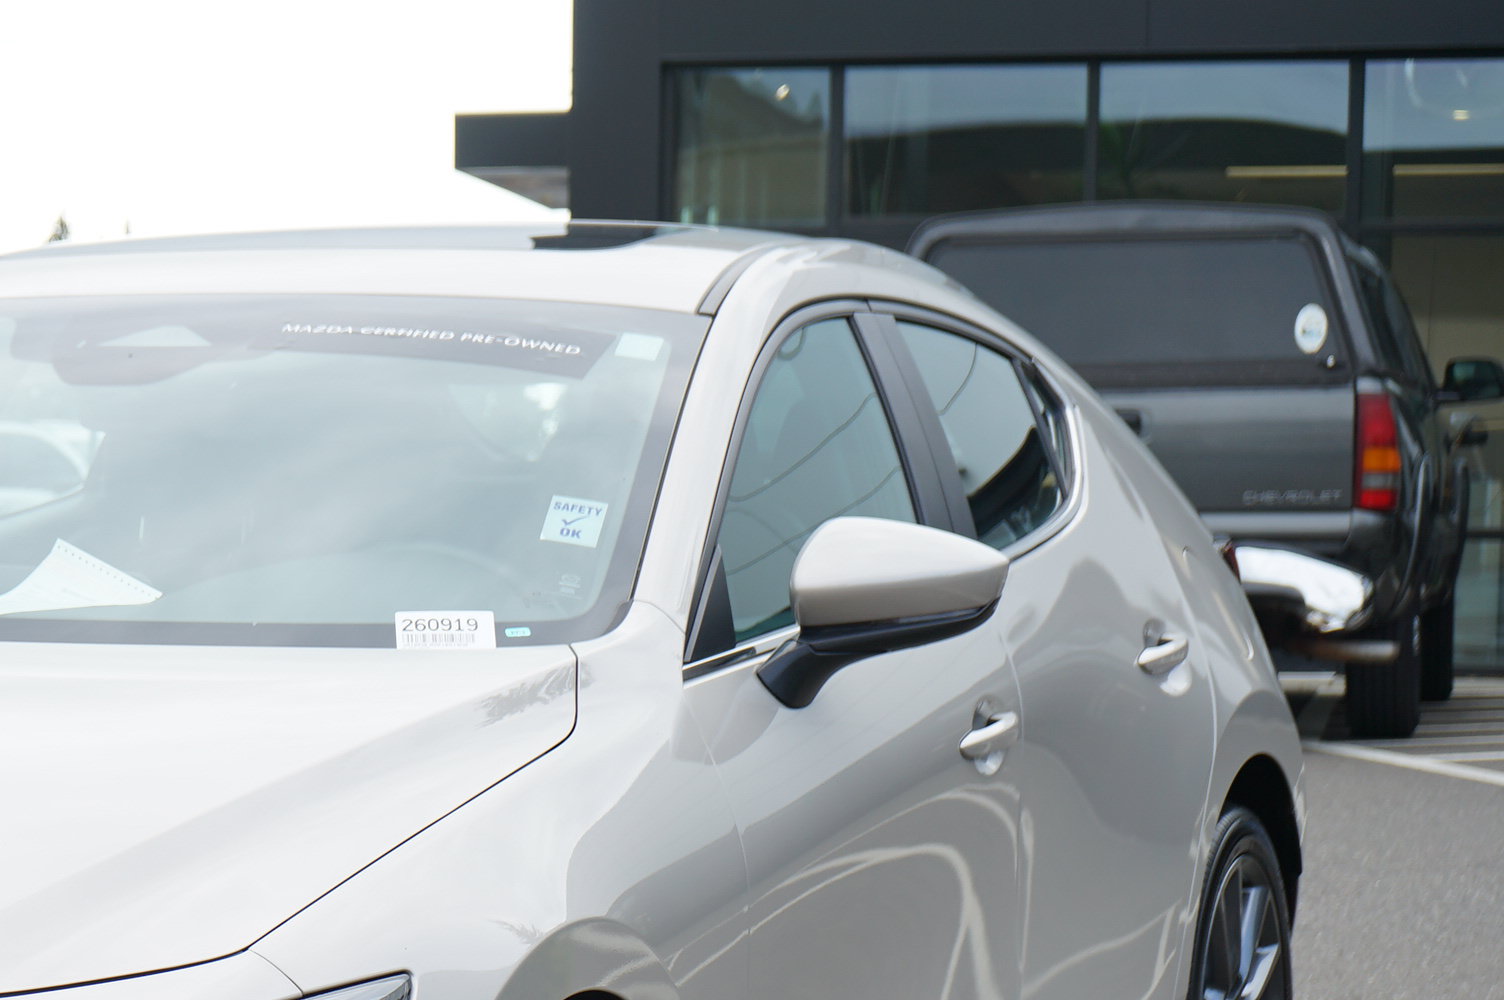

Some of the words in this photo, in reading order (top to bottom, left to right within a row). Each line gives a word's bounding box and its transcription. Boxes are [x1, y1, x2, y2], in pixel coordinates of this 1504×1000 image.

[282, 323, 353, 335] MAZDA
[360, 325, 455, 341] CERTIFIED
[459, 332, 581, 355] PRE-OWNED
[553, 501, 602, 516] SAFETY
[560, 527, 582, 539] OK
[401, 617, 479, 632] 260919
